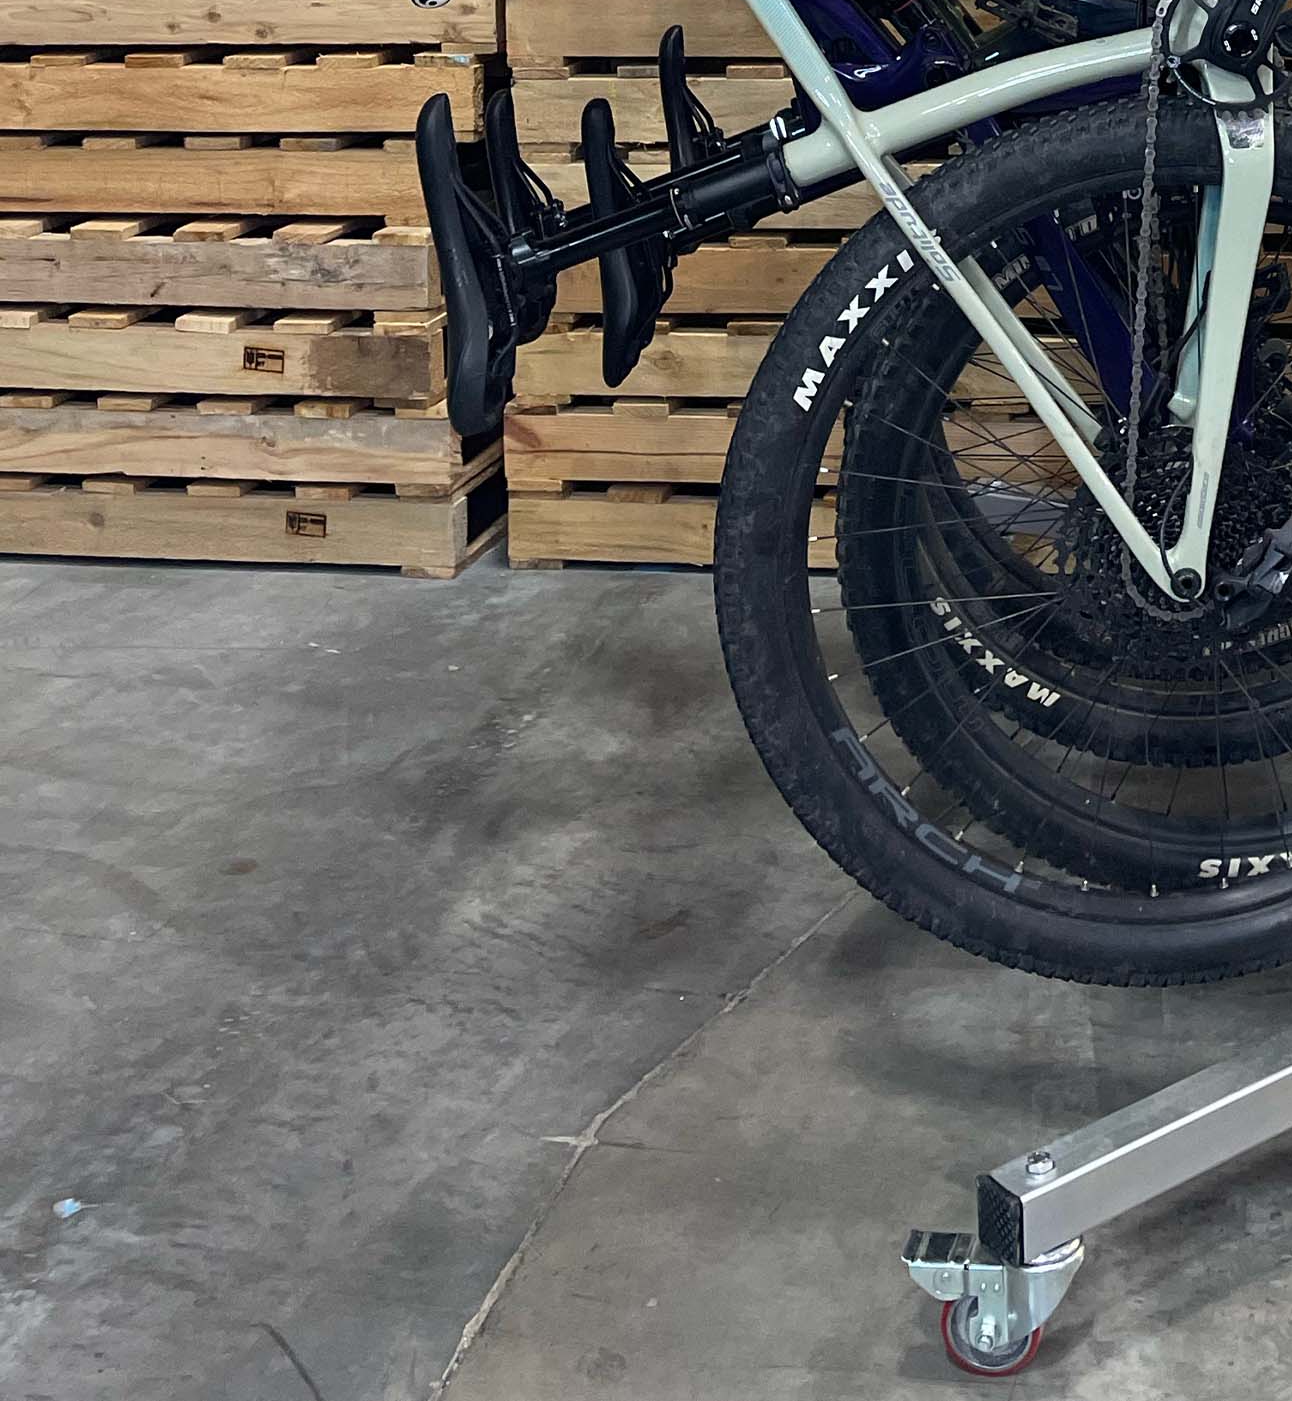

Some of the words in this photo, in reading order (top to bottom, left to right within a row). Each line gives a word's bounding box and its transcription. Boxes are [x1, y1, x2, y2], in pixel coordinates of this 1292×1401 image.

[878, 182, 961, 282] Solitude
[793, 236, 930, 412] MAXXI
[930, 596, 1061, 707] MAXXIS
[832, 728, 1022, 893] ARCH
